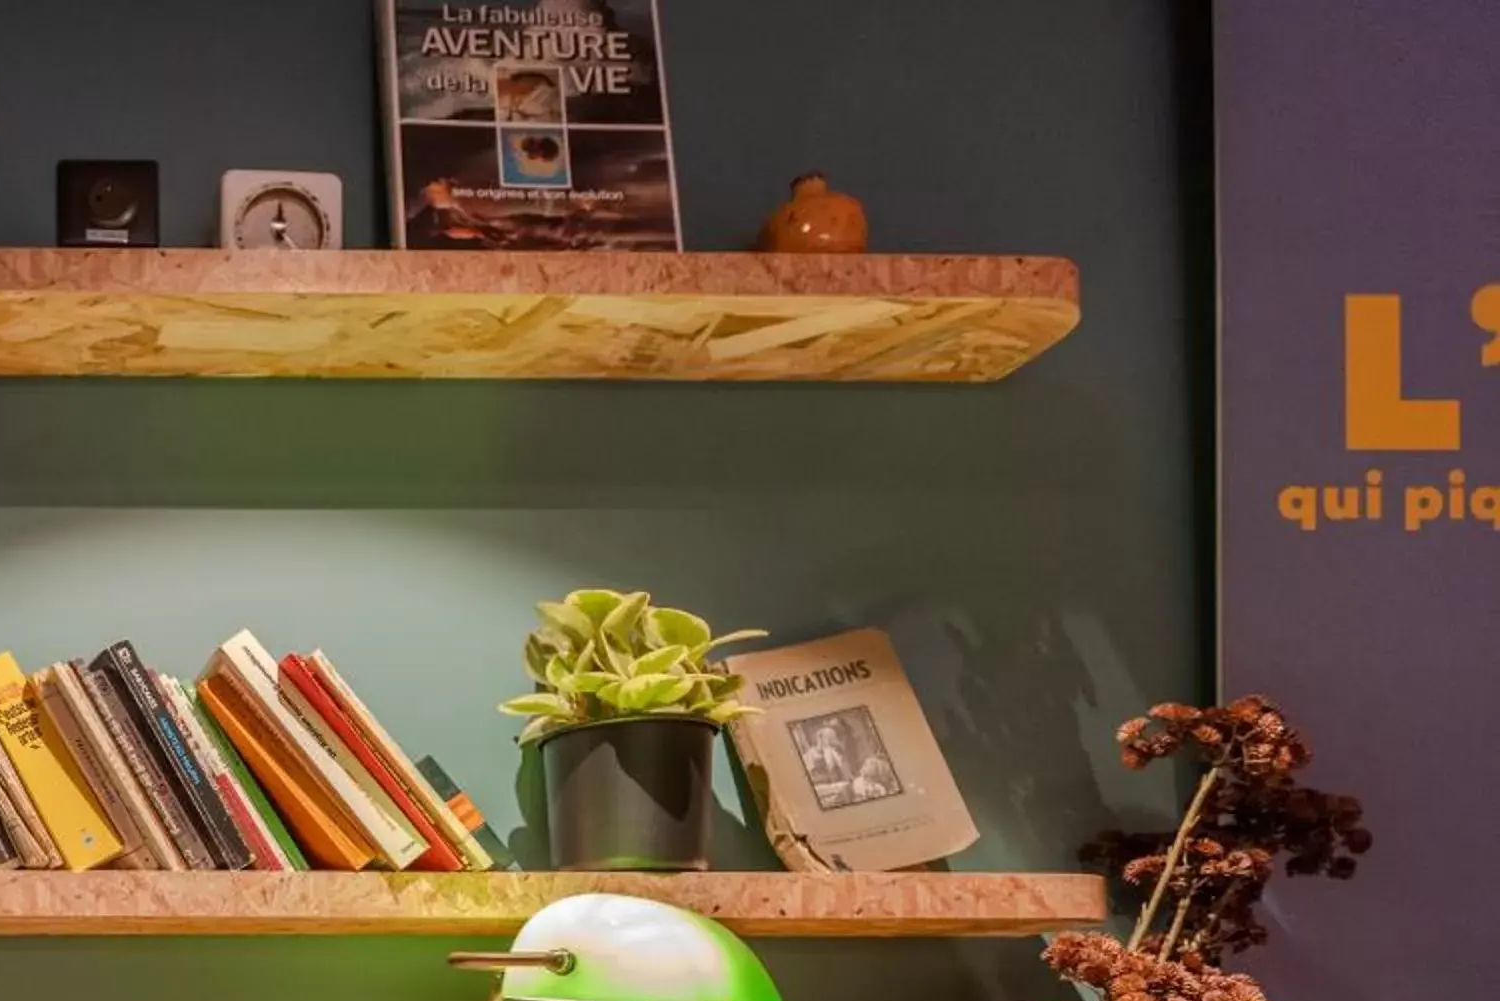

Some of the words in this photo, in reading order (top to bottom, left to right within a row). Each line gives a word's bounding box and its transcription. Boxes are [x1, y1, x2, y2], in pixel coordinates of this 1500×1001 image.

[443, 4, 471, 22] La
[479, 4, 603, 27] fabuleuse
[421, 28, 631, 59] AVENTURE
[427, 74, 459, 93] de
[464, 73, 488, 94] la
[569, 65, 631, 94] VIE
[477, 188, 525, 201] origines
[1277, 469, 1382, 531] qui
[1404, 469, 1500, 531] piq
[756, 659, 873, 700] INDICATIONS
